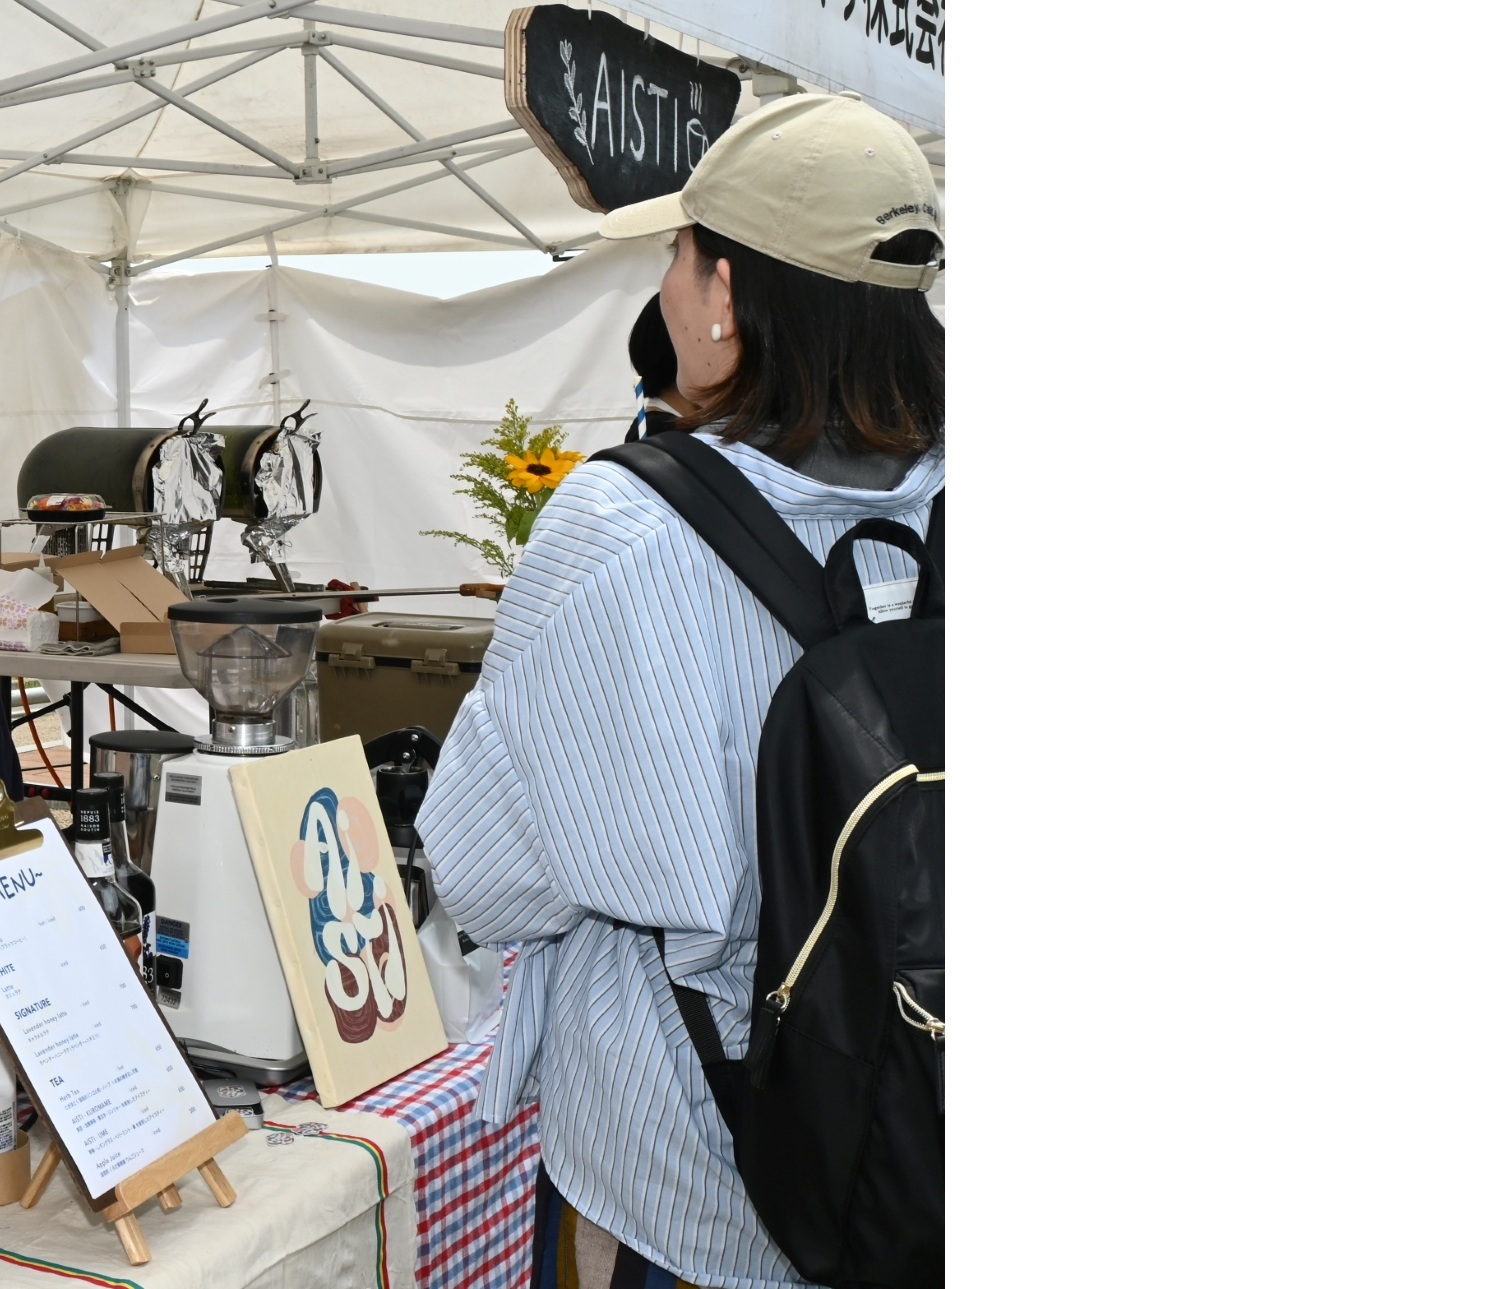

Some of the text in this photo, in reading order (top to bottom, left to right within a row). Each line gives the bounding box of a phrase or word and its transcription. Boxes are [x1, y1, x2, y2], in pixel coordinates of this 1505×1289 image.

[80, 814, 100, 823] 1883
[2, 984, 14, 993] Latte
[15, 998, 51, 1020] SIGNATURE
[24, 1022, 44, 1035] Lavender
[44, 1015, 58, 1026] honey
[35, 1032, 79, 1058] Lavender honey latte
[50, 1075, 64, 1088] TEA
[60, 1088, 80, 1102] Herb Tea
[86, 1099, 111, 1117] KUROMAME
[98, 1129, 108, 1139] UME
[96, 1158, 110, 1170] Apple
[109, 1151, 121, 1161] Juice
